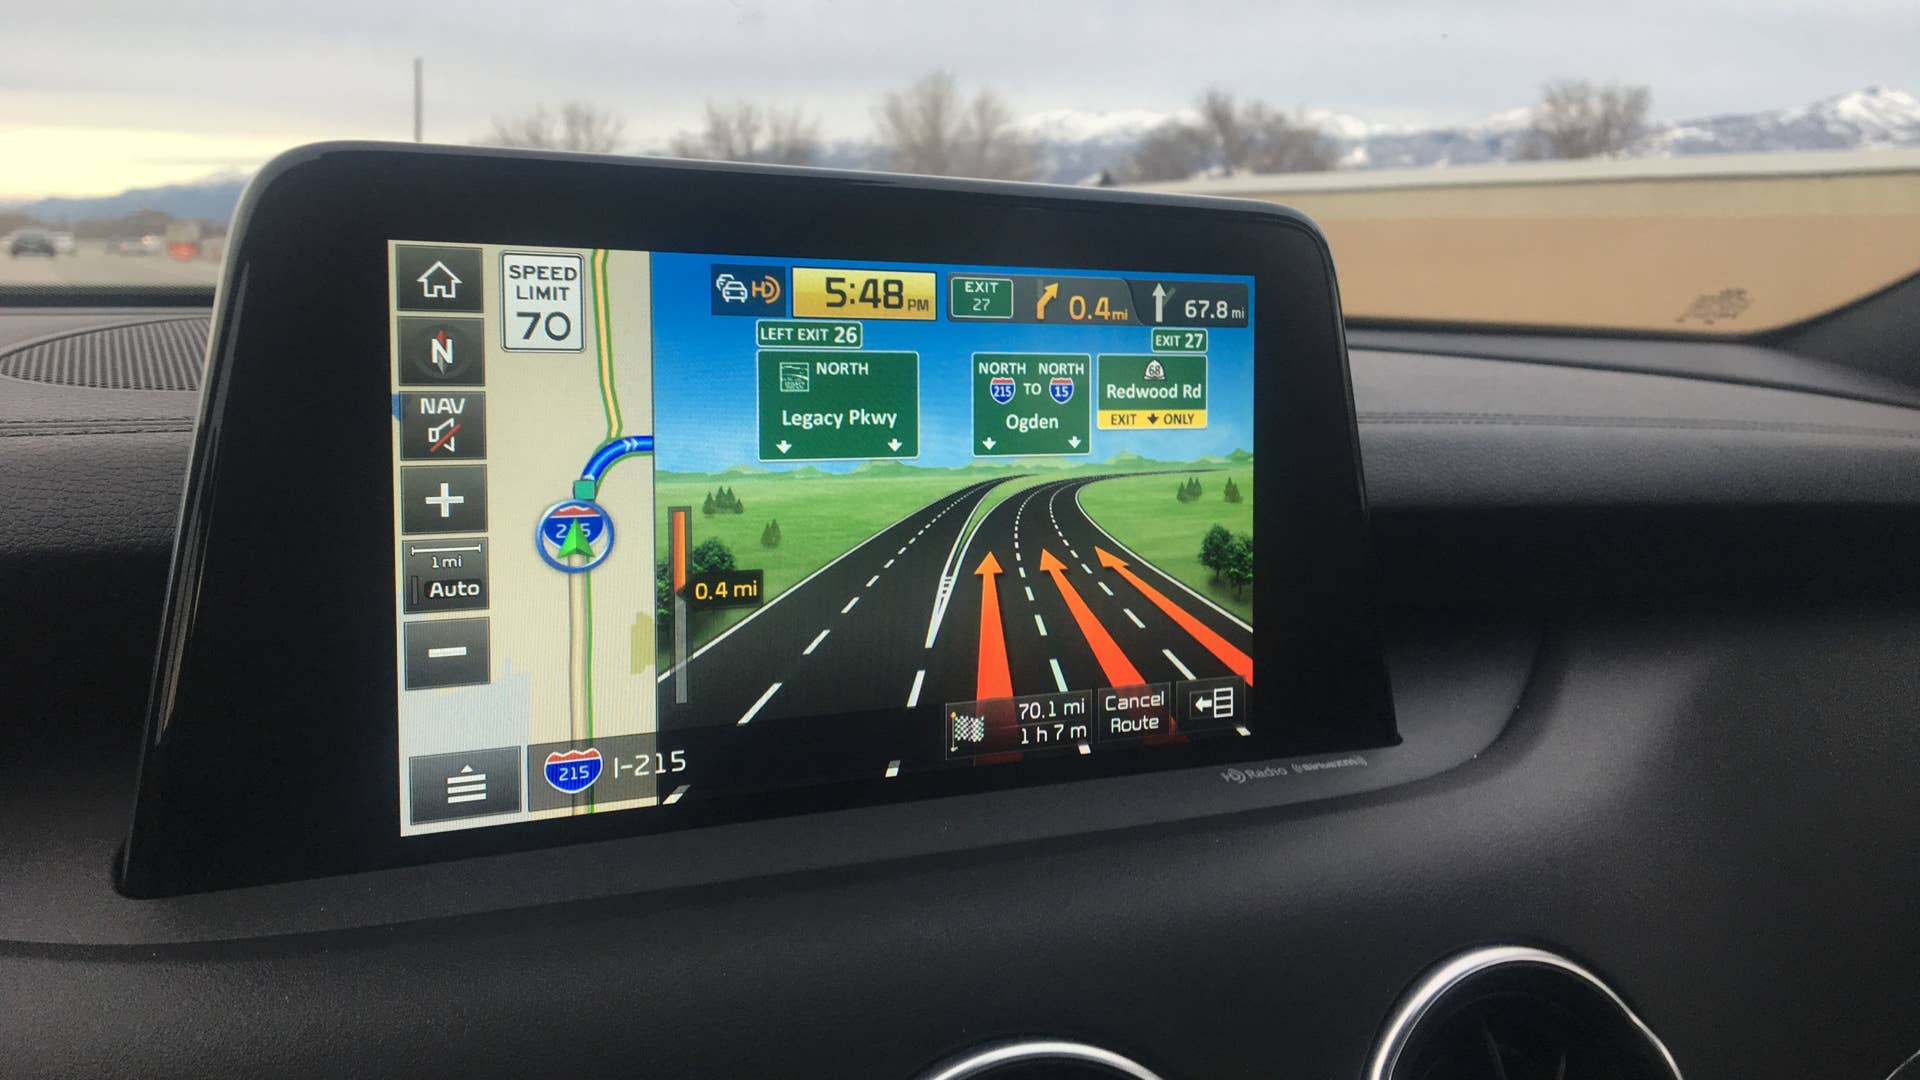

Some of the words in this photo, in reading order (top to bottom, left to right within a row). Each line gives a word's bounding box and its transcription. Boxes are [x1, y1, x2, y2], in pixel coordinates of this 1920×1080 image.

[509, 264, 578, 282] SPEED
[516, 285, 570, 301] LIMIT
[825, 276, 904, 310] 5:48
[907, 298, 930, 312] PM
[964, 281, 999, 294] EXIT
[972, 298, 991, 312] 27
[1068, 295, 1111, 321] 0.4
[1184, 299, 1228, 320] 67.8
[1231, 307, 1246, 319] mi
[516, 311, 572, 342] 70
[760, 327, 794, 341] LEFT
[797, 328, 830, 342] EXIT
[833, 326, 858, 344] 26
[1155, 334, 1182, 347] EXIT
[1184, 333, 1204, 349] 27
[431, 338, 454, 364] N
[816, 361, 870, 376] NORTH
[978, 362, 1027, 375] NORTH
[1038, 362, 1085, 376] NORTH
[1148, 363, 1162, 376] 68
[993, 385, 1012, 398] 215
[1023, 382, 1042, 396] TO
[1054, 385, 1069, 398] 15
[1106, 383, 1178, 400] Redwood
[1182, 383, 1202, 399] Rd
[420, 397, 466, 415] NAV
[781, 409, 844, 430] Legacy
[849, 408, 898, 429] Pkwy
[1005, 413, 1060, 434] Ogden
[1110, 413, 1137, 426] EXIT
[1163, 413, 1195, 426] ONLY
[555, 522, 592, 540] 25
[429, 580, 481, 599] Auto
[695, 581, 729, 601] 0.4
[733, 580, 759, 598] mi
[1018, 700, 1057, 721] 70.1
[1063, 696, 1086, 716] mi
[1105, 690, 1166, 712] Cancel
[1110, 714, 1160, 734] Route
[1020, 727, 1030, 745] 1
[1036, 725, 1049, 743] h
[1054, 723, 1065, 742] 7
[1070, 723, 1088, 739] m
[559, 764, 591, 782] 215
[613, 749, 687, 780] I-215
